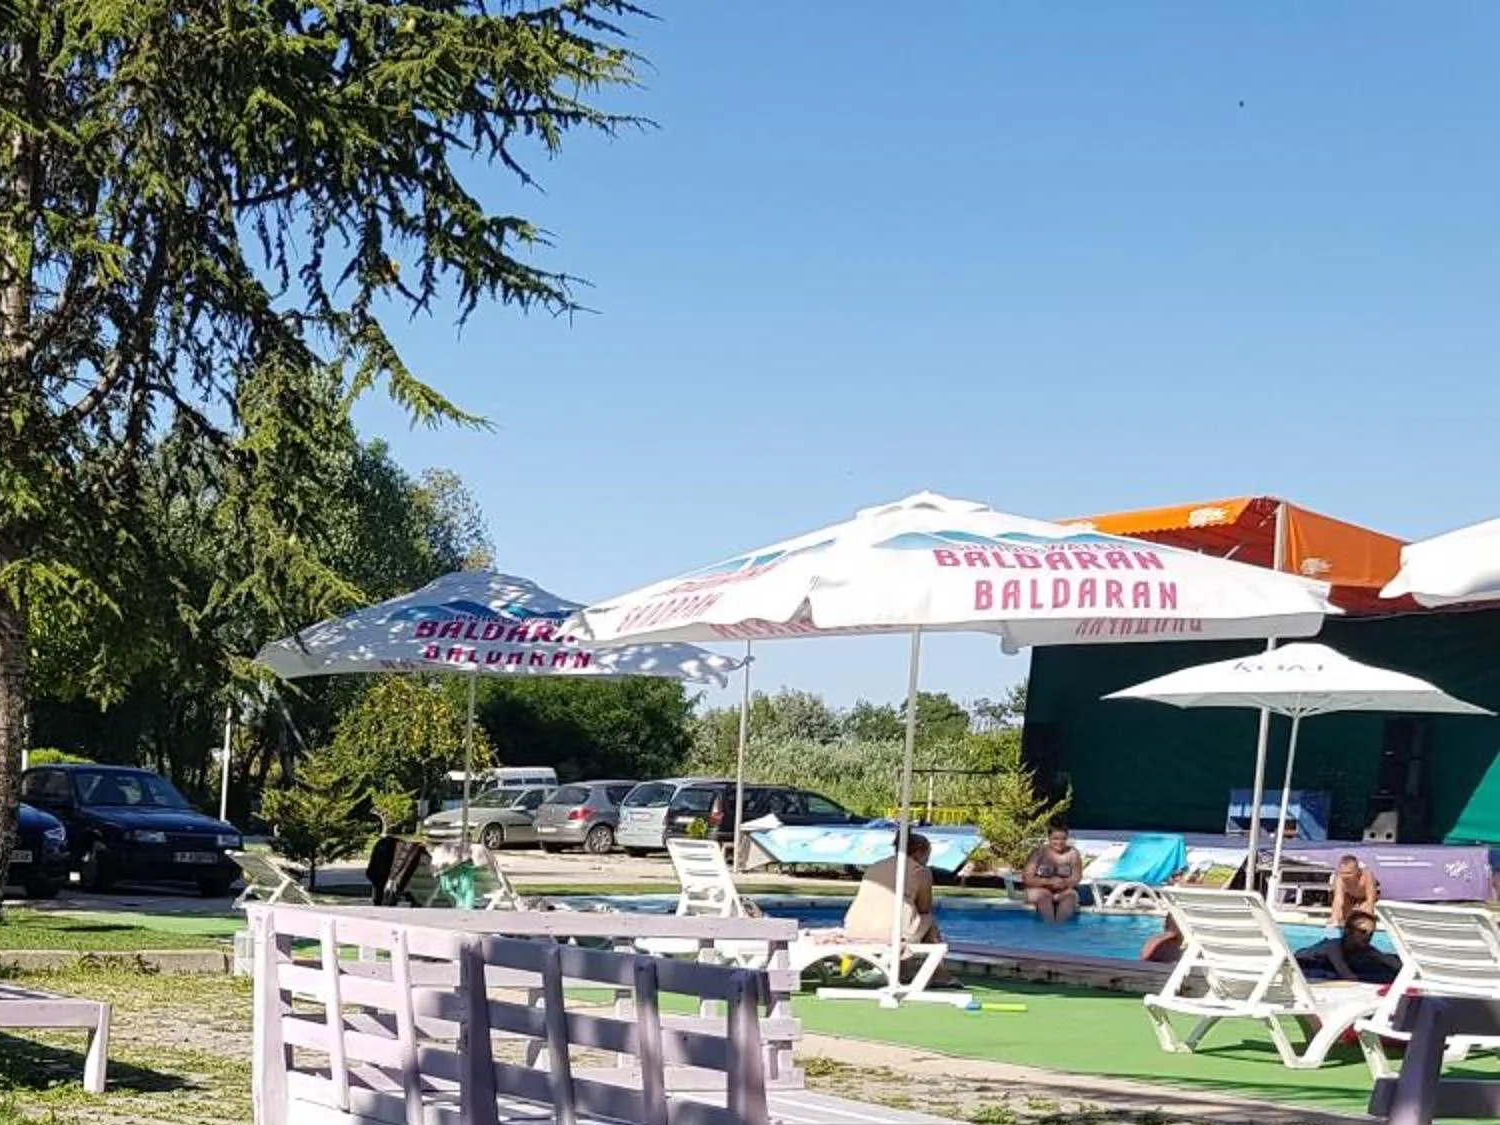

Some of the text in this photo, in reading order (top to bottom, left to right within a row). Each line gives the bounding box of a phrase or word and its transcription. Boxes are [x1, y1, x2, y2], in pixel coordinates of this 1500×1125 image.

[933, 549, 1165, 570] BALDARAN
[974, 577, 1178, 611] BALDARAN
[415, 610, 578, 643] BALDAR
[423, 644, 592, 669] BALDARAN
